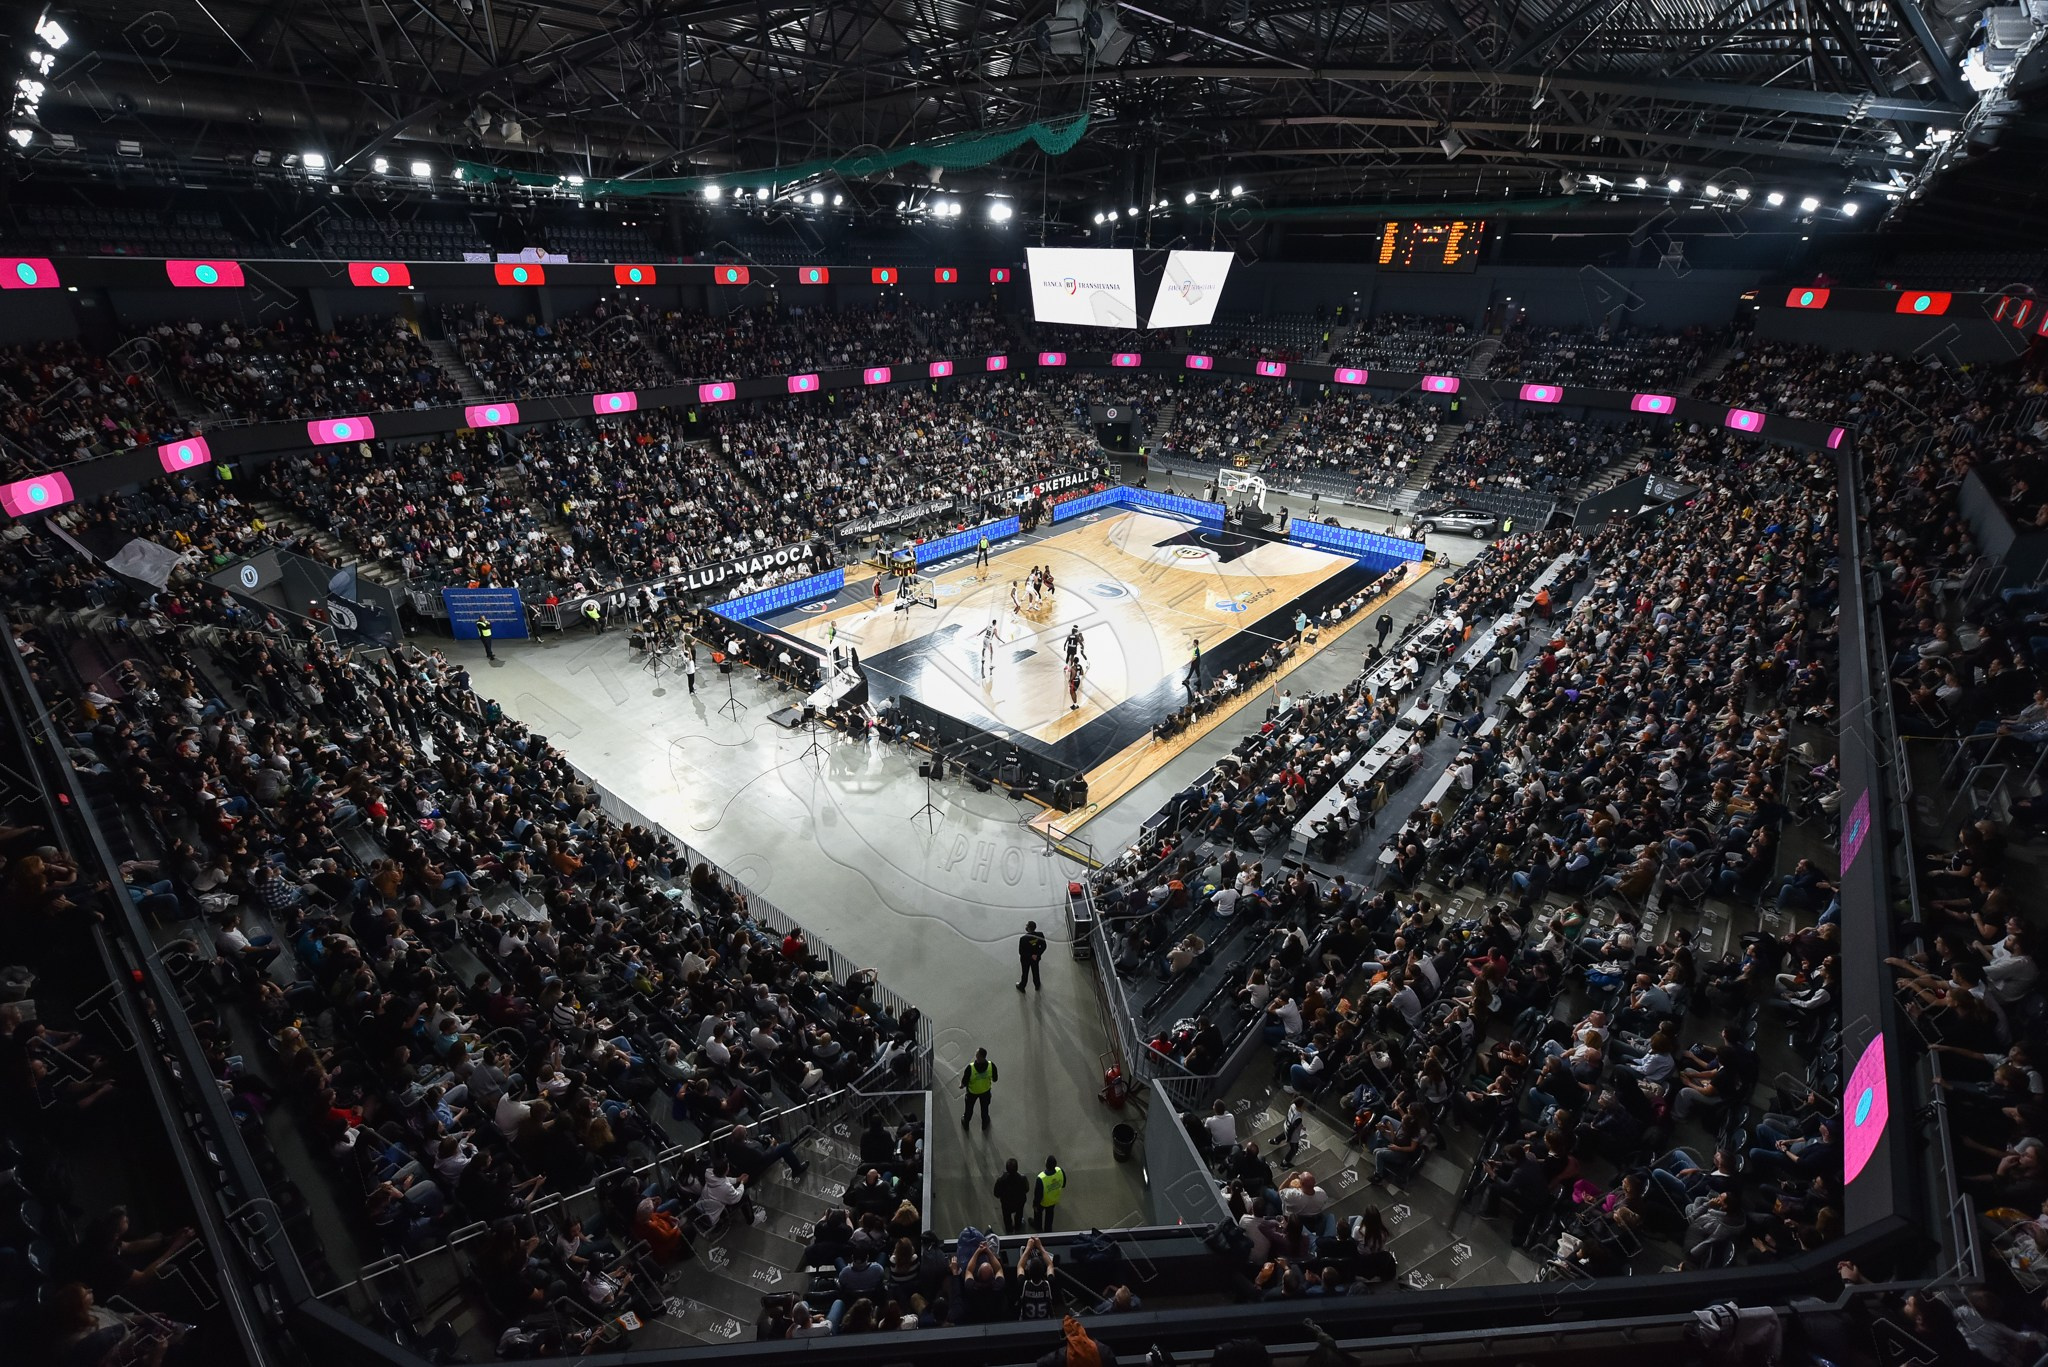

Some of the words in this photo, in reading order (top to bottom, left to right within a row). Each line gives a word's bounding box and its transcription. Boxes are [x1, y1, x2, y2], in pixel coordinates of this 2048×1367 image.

[1023, 471, 1090, 496] BSKETBALL
[789, 1225, 808, 1238] L11-13
[752, 1269, 773, 1283] L11-14
[1025, 1302, 1048, 1318] 35
[709, 1322, 731, 1338] L11-18
[725, 1318, 735, 1329] R9
